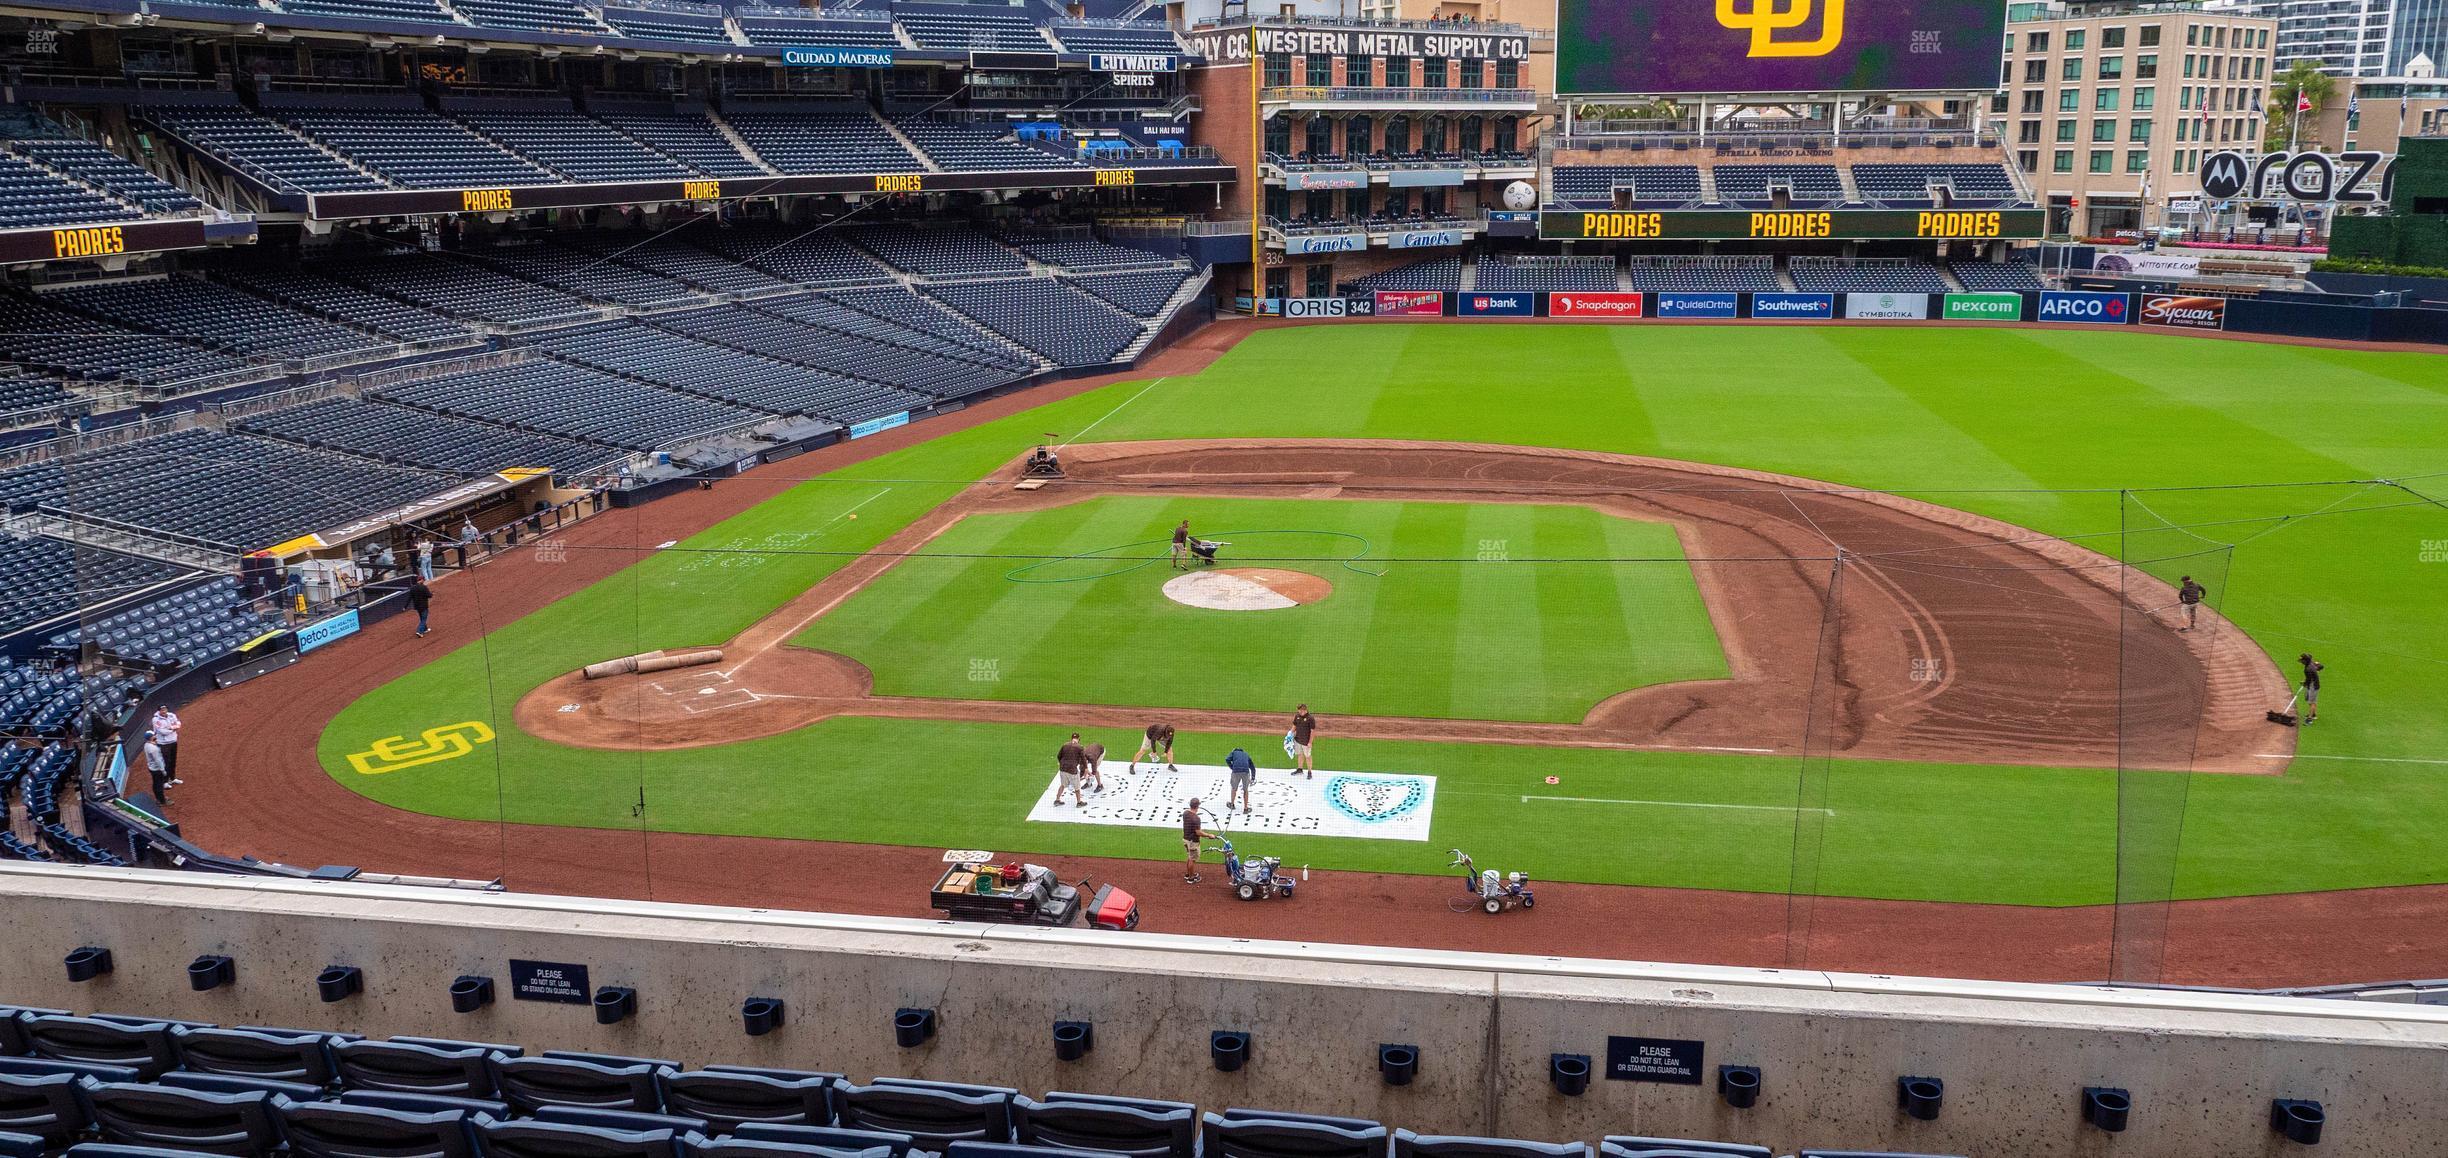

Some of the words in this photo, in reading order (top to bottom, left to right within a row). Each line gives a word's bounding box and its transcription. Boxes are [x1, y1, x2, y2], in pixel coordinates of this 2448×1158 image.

[1194, 36, 1222, 61] PLY
[1226, 33, 1252, 59] CO.
[1255, 30, 1349, 55] WESTERN
[1358, 33, 1419, 56] METAL
[1424, 35, 1493, 58] SUPPLY
[1499, 38, 1527, 59] CO.
[1100, 55, 1168, 71] CUTWATER
[1113, 74, 1155, 86] SPIRITS
[1143, 126, 1157, 135] BALI
[1159, 126, 1170, 135] HAI
[1171, 126, 1185, 135] RUM
[1716, 149, 1757, 157] ESTRELLA
[1759, 149, 1793, 157] JALISCO
[1796, 149, 1833, 157] LANDING
[875, 174, 922, 191] PADRES
[1095, 169, 1135, 185] PADRES
[684, 181, 720, 200] PADRES
[463, 189, 512, 211] PADRES
[1583, 213, 1661, 237] PADRES
[1750, 213, 1831, 237] PADRES
[1917, 212, 2000, 236] PADRES
[54, 226, 124, 258] PADRES
[1303, 236, 1353, 253] Canel's
[1403, 231, 1450, 248] Canel's
[1265, 252, 1284, 265] 336
[1288, 300, 1344, 316] ORIS
[1350, 301, 1371, 314] 342
[1474, 299, 1488, 308] us
[1490, 298, 1517, 308] bank
[1576, 299, 1636, 311] Snapdragon
[1676, 299, 1732, 310] QuidelOrtho
[1758, 300, 1819, 311] Southwest
[2041, 299, 2103, 316] ARCO
[2145, 297, 2215, 324] Sycuan
[300, 628, 328, 650] petco
[537, 969, 563, 979] PLEASE
[529, 985, 545, 993] STAND
[553, 988, 571, 996] GUARD
[1640, 1046, 1671, 1057] PLEASE
[1630, 1056, 1639, 1064] DO
[1664, 1058, 1679, 1066] LEAN
[1627, 1064, 1647, 1072] STAND
[1647, 1065, 1656, 1073] ON
[1657, 1066, 1677, 1075] GUARD
[1678, 1067, 1691, 1076] RAIL
